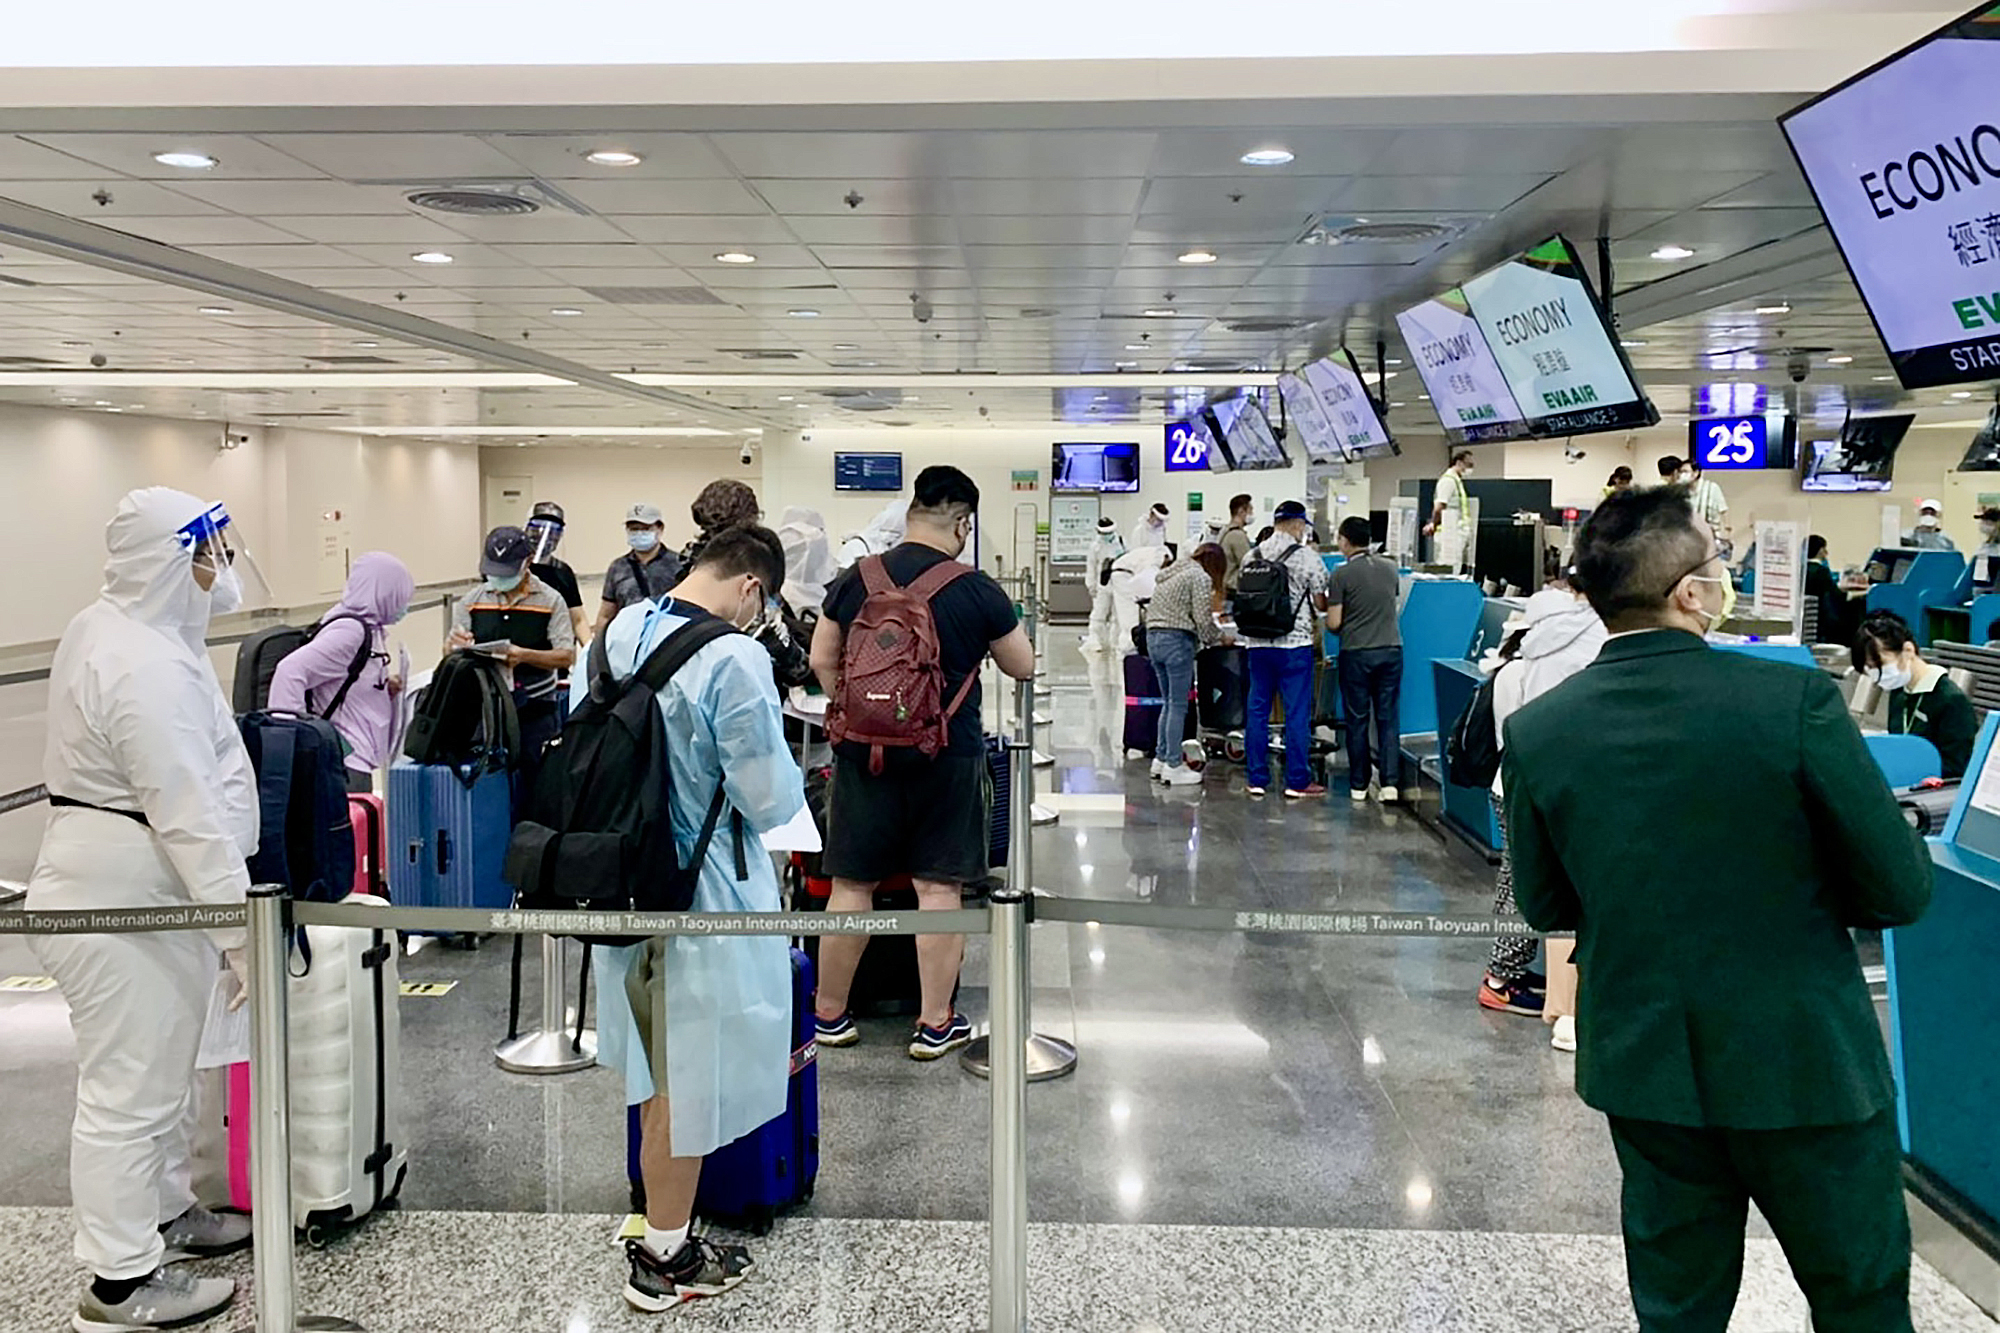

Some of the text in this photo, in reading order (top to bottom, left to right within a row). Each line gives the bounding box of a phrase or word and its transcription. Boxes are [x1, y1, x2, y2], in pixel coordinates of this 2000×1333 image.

[1496, 297, 1573, 346] ECONOMY
[1421, 333, 1477, 369] ECONOMY
[1171, 429, 1201, 463] 26
[1707, 421, 1754, 463] 25
[28, 914, 86, 932] Taoyuan
[91, 909, 188, 928] International
[192, 908, 246, 926] Airport
[624, 914, 676, 929] Taiwan
[680, 915, 742, 932] Taoyuan
[746, 916, 840, 931] International
[843, 915, 898, 932] Airport
[1371, 915, 1423, 930] Taiwan
[1427, 916, 1490, 934] Taoyuan
